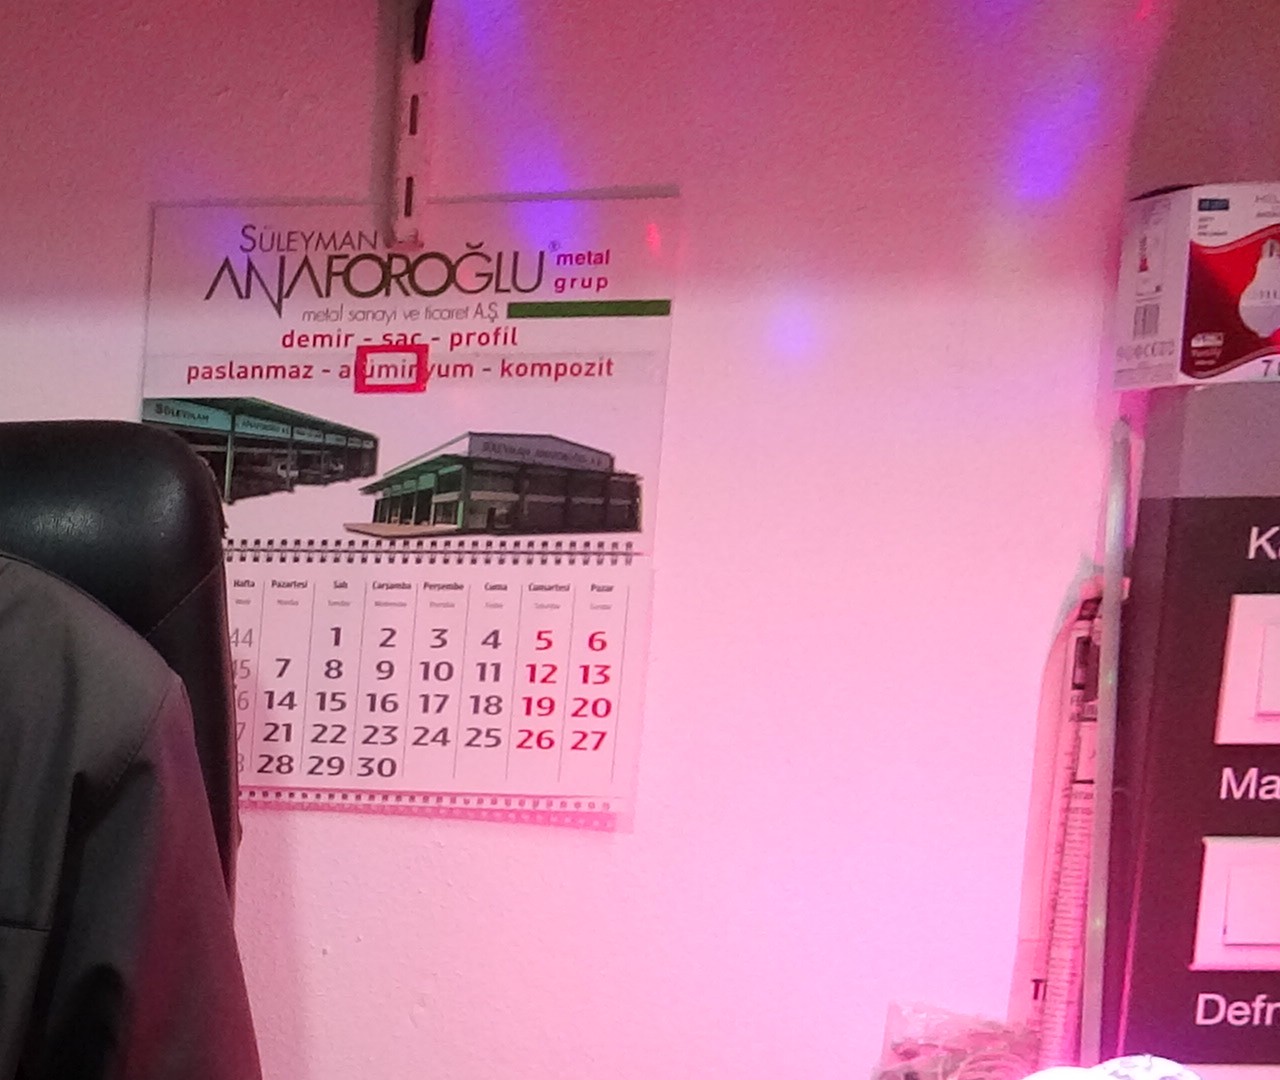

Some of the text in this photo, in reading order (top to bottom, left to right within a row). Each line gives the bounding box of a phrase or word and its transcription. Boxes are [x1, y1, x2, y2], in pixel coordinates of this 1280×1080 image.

[239, 224, 378, 254] SÜLEYMAN
[555, 247, 610, 268] metal
[203, 242, 545, 319] ANAFOROĞLU
[554, 273, 609, 294] grup
[302, 304, 344, 323] metal
[347, 307, 398, 325] sanayi
[401, 308, 421, 321] ve
[424, 303, 470, 321] ticaret
[280, 326, 519, 354] demir sac profil
[186, 360, 314, 384] paslanmaz
[500, 356, 615, 383] kompozit
[1246, 526, 1280, 561] K
[330, 627, 342, 647] 1
[378, 628, 398, 648] 2
[430, 628, 449, 649] 3
[481, 629, 503, 650] 4
[535, 630, 553, 651] 5
[587, 631, 608, 652] 6
[275, 658, 292, 678] 7
[324, 659, 344, 679] 8
[375, 660, 395, 680] 9
[419, 660, 454, 682] 10
[475, 662, 502, 683] 11
[526, 663, 558, 685] 12
[579, 664, 612, 686] 13
[263, 690, 298, 711] 14
[315, 691, 347, 712] 15
[365, 693, 399, 713] 16
[418, 694, 450, 715] 17
[469, 694, 503, 716] 18
[522, 696, 556, 717] 19
[570, 697, 612, 719] 20
[262, 722, 608, 752] 21 22 23 24 25 26 27
[256, 753, 397, 778] 28 29 30
